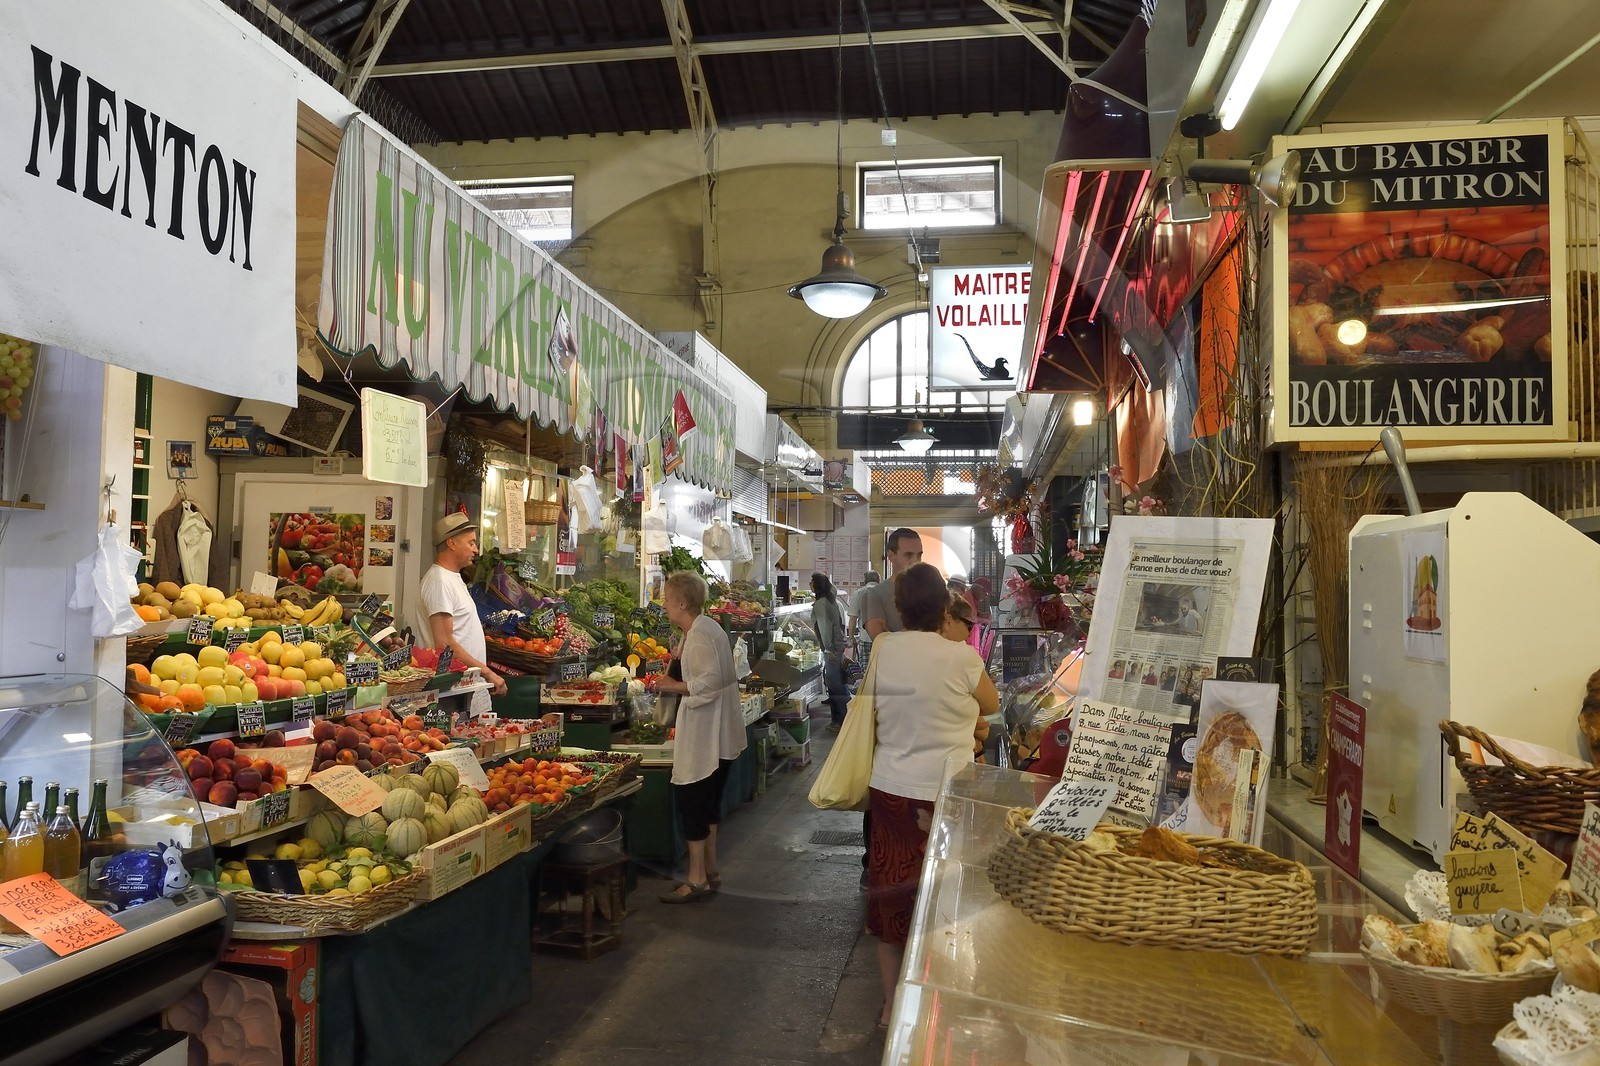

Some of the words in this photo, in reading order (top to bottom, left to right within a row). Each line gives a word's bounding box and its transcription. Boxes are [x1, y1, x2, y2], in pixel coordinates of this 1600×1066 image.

[25, 44, 257, 271] MENTON
[1304, 147, 1360, 174] AU
[1372, 138, 1526, 171] BAISER
[1294, 179, 1349, 207] DU
[1370, 170, 1545, 204] MITRON
[367, 171, 435, 340] AU
[954, 272, 1031, 296] MAITRE
[936, 304, 1028, 327] VOLAILL
[1289, 377, 1546, 426] BOULANGERIE
[1129, 563, 1153, 573] France
[1154, 565, 1164, 573] en
[1164, 565, 1178, 574] bas
[1179, 566, 1189, 575] de
[1190, 567, 1208, 576] chez
[1209, 567, 1232, 577] vous?
[1140, 554, 1171, 564] meilleur
[1172, 556, 1212, 567] boulanger
[1212, 558, 1223, 566] de
[1080, 704, 1105, 717] Dans
[1133, 710, 1173, 733] boutique
[1073, 732, 1120, 750] proposons,
[1121, 742, 1138, 752] nos
[1140, 743, 1169, 759] gâtea
[1087, 721, 1101, 729] rue
[1130, 729, 1151, 741] nous
[1153, 733, 1171, 745] vou
[1068, 755, 1092, 768] citron
[1093, 760, 1102, 770] de
[1104, 761, 1145, 782] Menton,
[1146, 773, 1158, 782] et
[1072, 743, 1102, 761] Russes,
[1103, 751, 1127, 763] notre
[1128, 755, 1153, 769] tarte
[1053, 783, 1107, 797] Brioches
[1065, 766, 1106, 782] spécialités
[1126, 782, 1151, 796] saveur
[1045, 796, 1103, 811] grillées
[1125, 799, 1147, 813] choix
[1133, 792, 1146, 804] du
[1067, 807, 1080, 818] le
[1448, 855, 1497, 883] lardons
